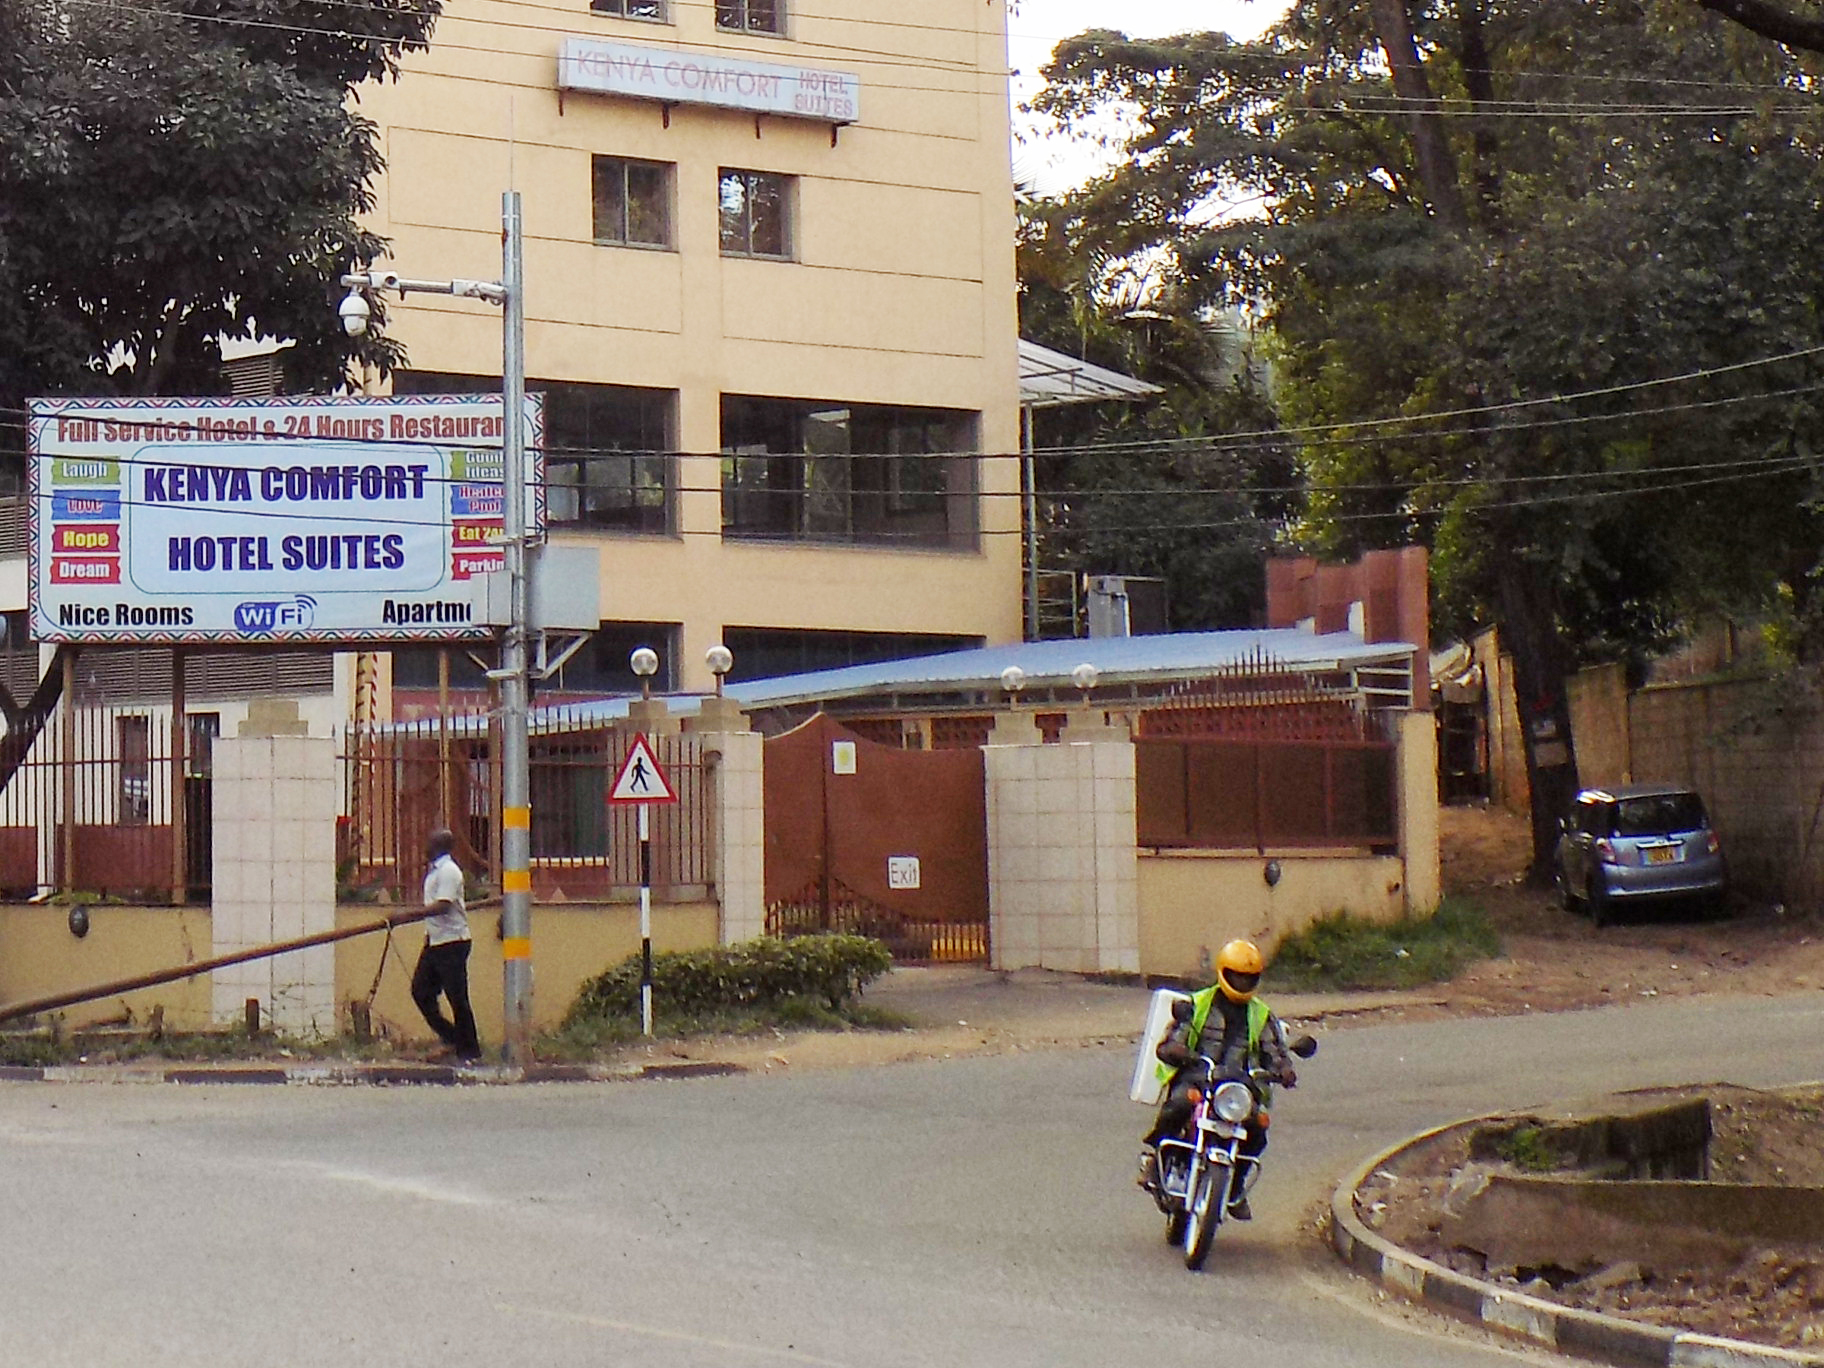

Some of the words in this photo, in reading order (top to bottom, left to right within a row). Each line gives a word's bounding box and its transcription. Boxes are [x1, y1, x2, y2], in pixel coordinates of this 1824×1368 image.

[578, 49, 656, 84] KENYA
[663, 60, 780, 99] COMFORT
[800, 71, 848, 95] HOTEL
[794, 93, 853, 117] SUITES
[57, 417, 99, 443] Full
[104, 417, 192, 443] Service
[196, 416, 258, 442] Hotel
[283, 415, 312, 439] 24
[316, 415, 384, 440] Hours
[390, 414, 504, 439] Restauran
[62, 461, 108, 479] Laugh
[144, 466, 252, 502] KENYA
[260, 464, 429, 502] COMFORT
[459, 485, 504, 499] Heate
[67, 497, 104, 514] Love
[62, 530, 110, 549] Hope
[459, 525, 481, 541] Eat
[168, 536, 274, 572] HOTEL
[282, 534, 405, 571] SUITES
[59, 561, 110, 578] Dream
[459, 559, 505, 573] Parkin
[58, 603, 110, 626] Nice
[115, 603, 194, 626] Rooms
[890, 862, 918, 884] Exit
